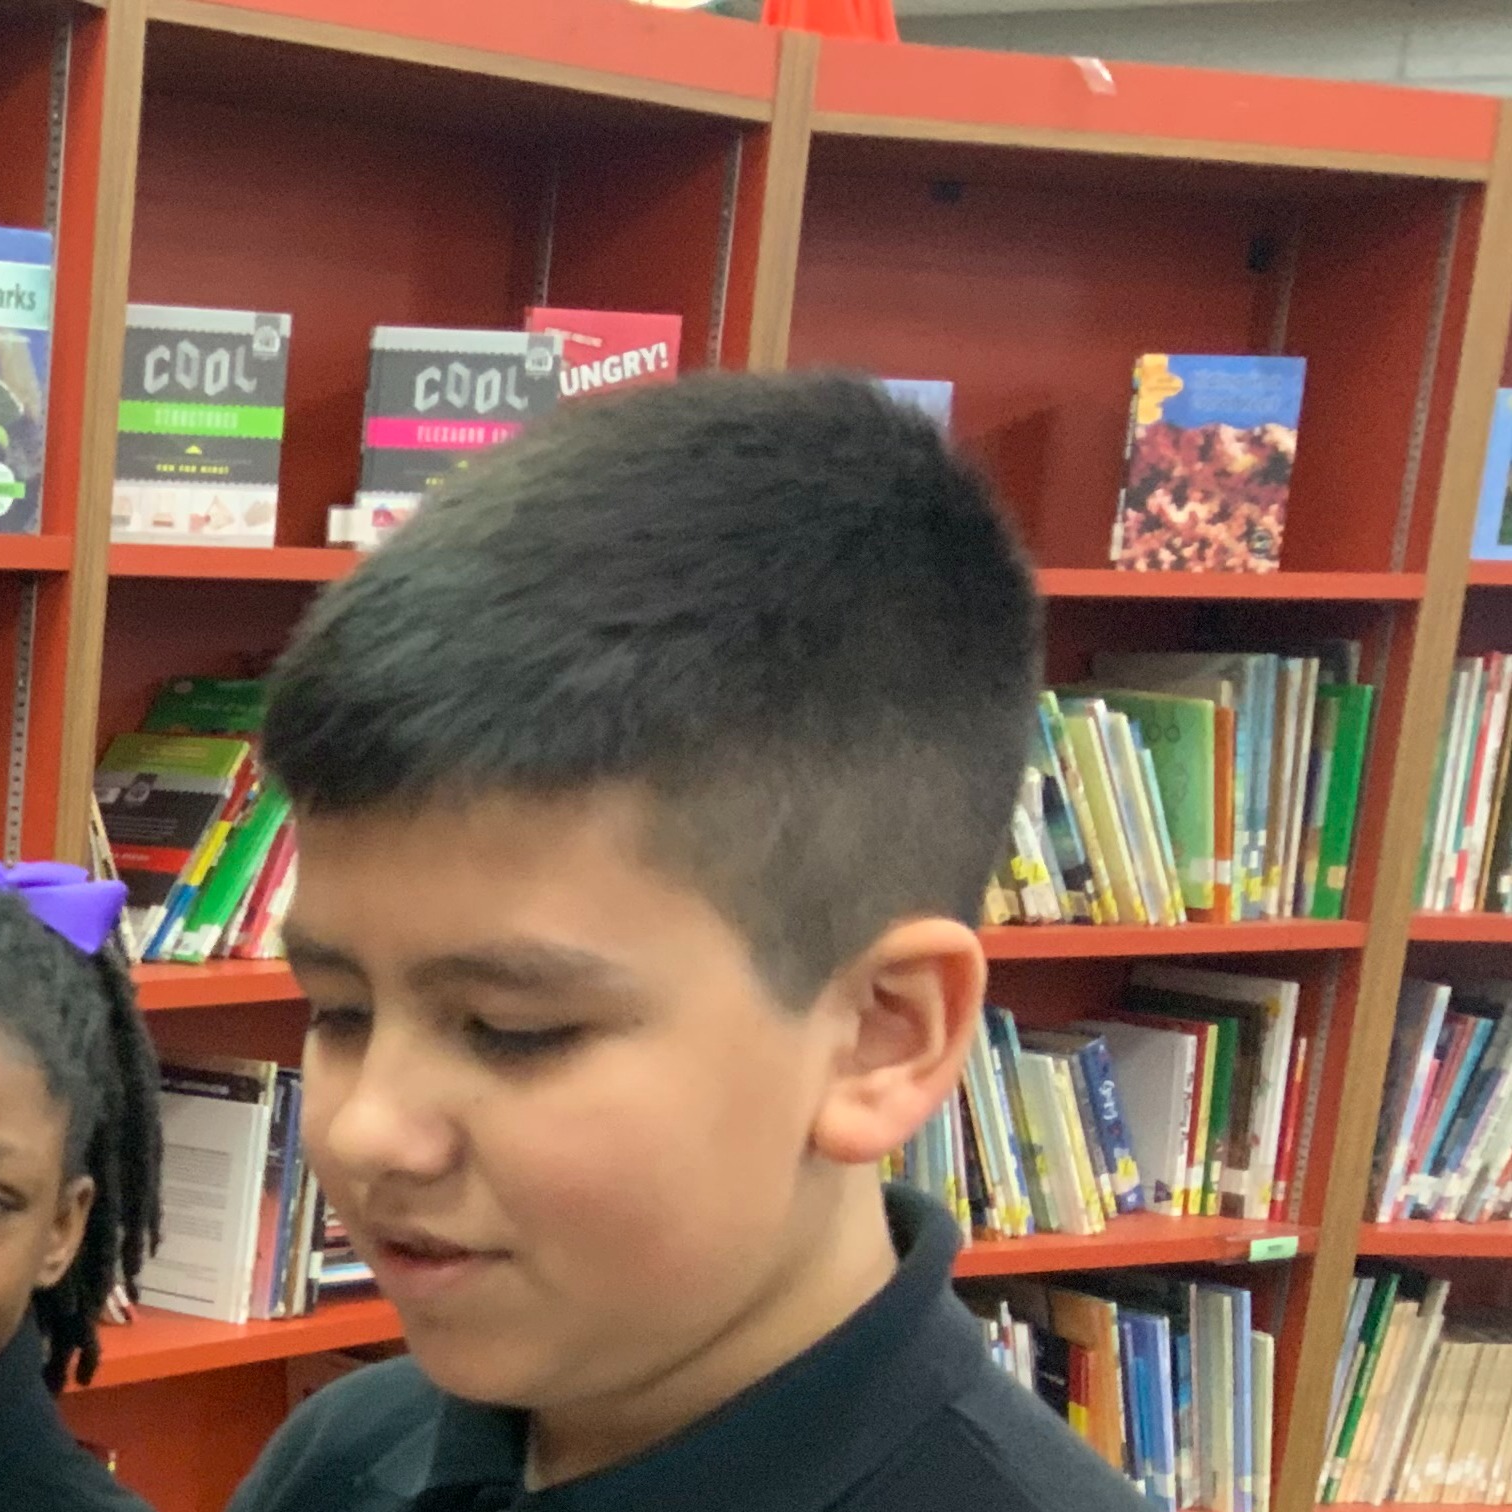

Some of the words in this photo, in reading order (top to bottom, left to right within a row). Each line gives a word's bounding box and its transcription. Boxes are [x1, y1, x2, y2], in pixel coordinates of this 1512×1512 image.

[143, 338, 258, 396] COOL
[414, 361, 529, 414] COOL
[558, 341, 669, 398] UNGRY!
